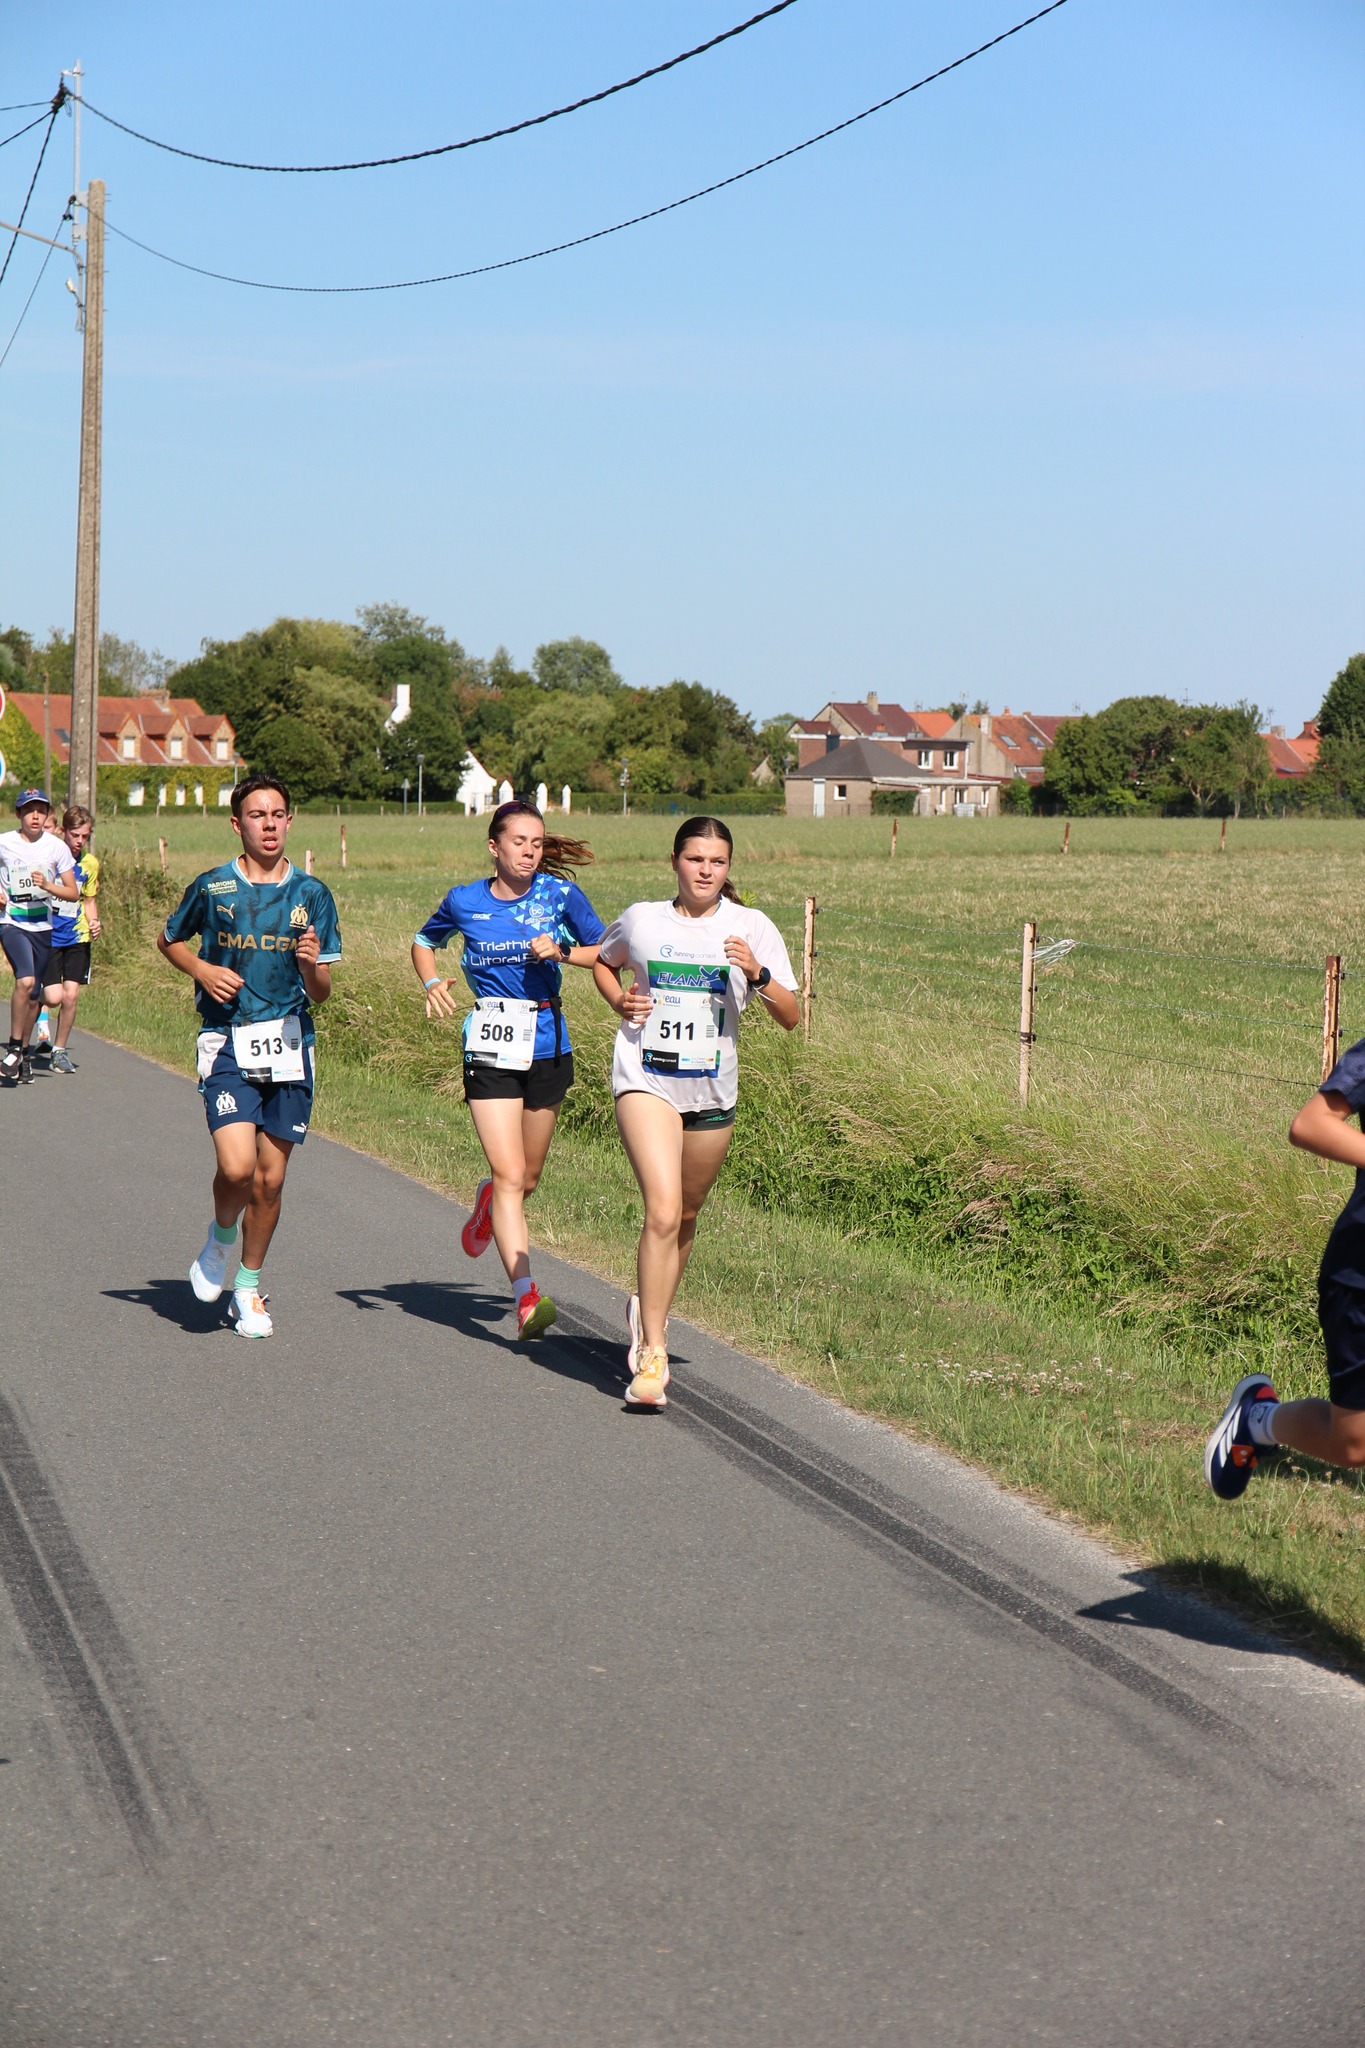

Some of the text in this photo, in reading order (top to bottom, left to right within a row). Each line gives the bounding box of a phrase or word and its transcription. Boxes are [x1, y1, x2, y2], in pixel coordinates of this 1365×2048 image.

[19, 878, 36, 888] 50
[218, 931, 258, 950] CMA
[477, 940, 530, 952] Triathlo
[470, 953, 521, 966] Littoral
[656, 971, 702, 987] ELAN
[480, 1023, 514, 1042] 508
[660, 1020, 694, 1041] 511
[250, 1037, 283, 1057] 513
